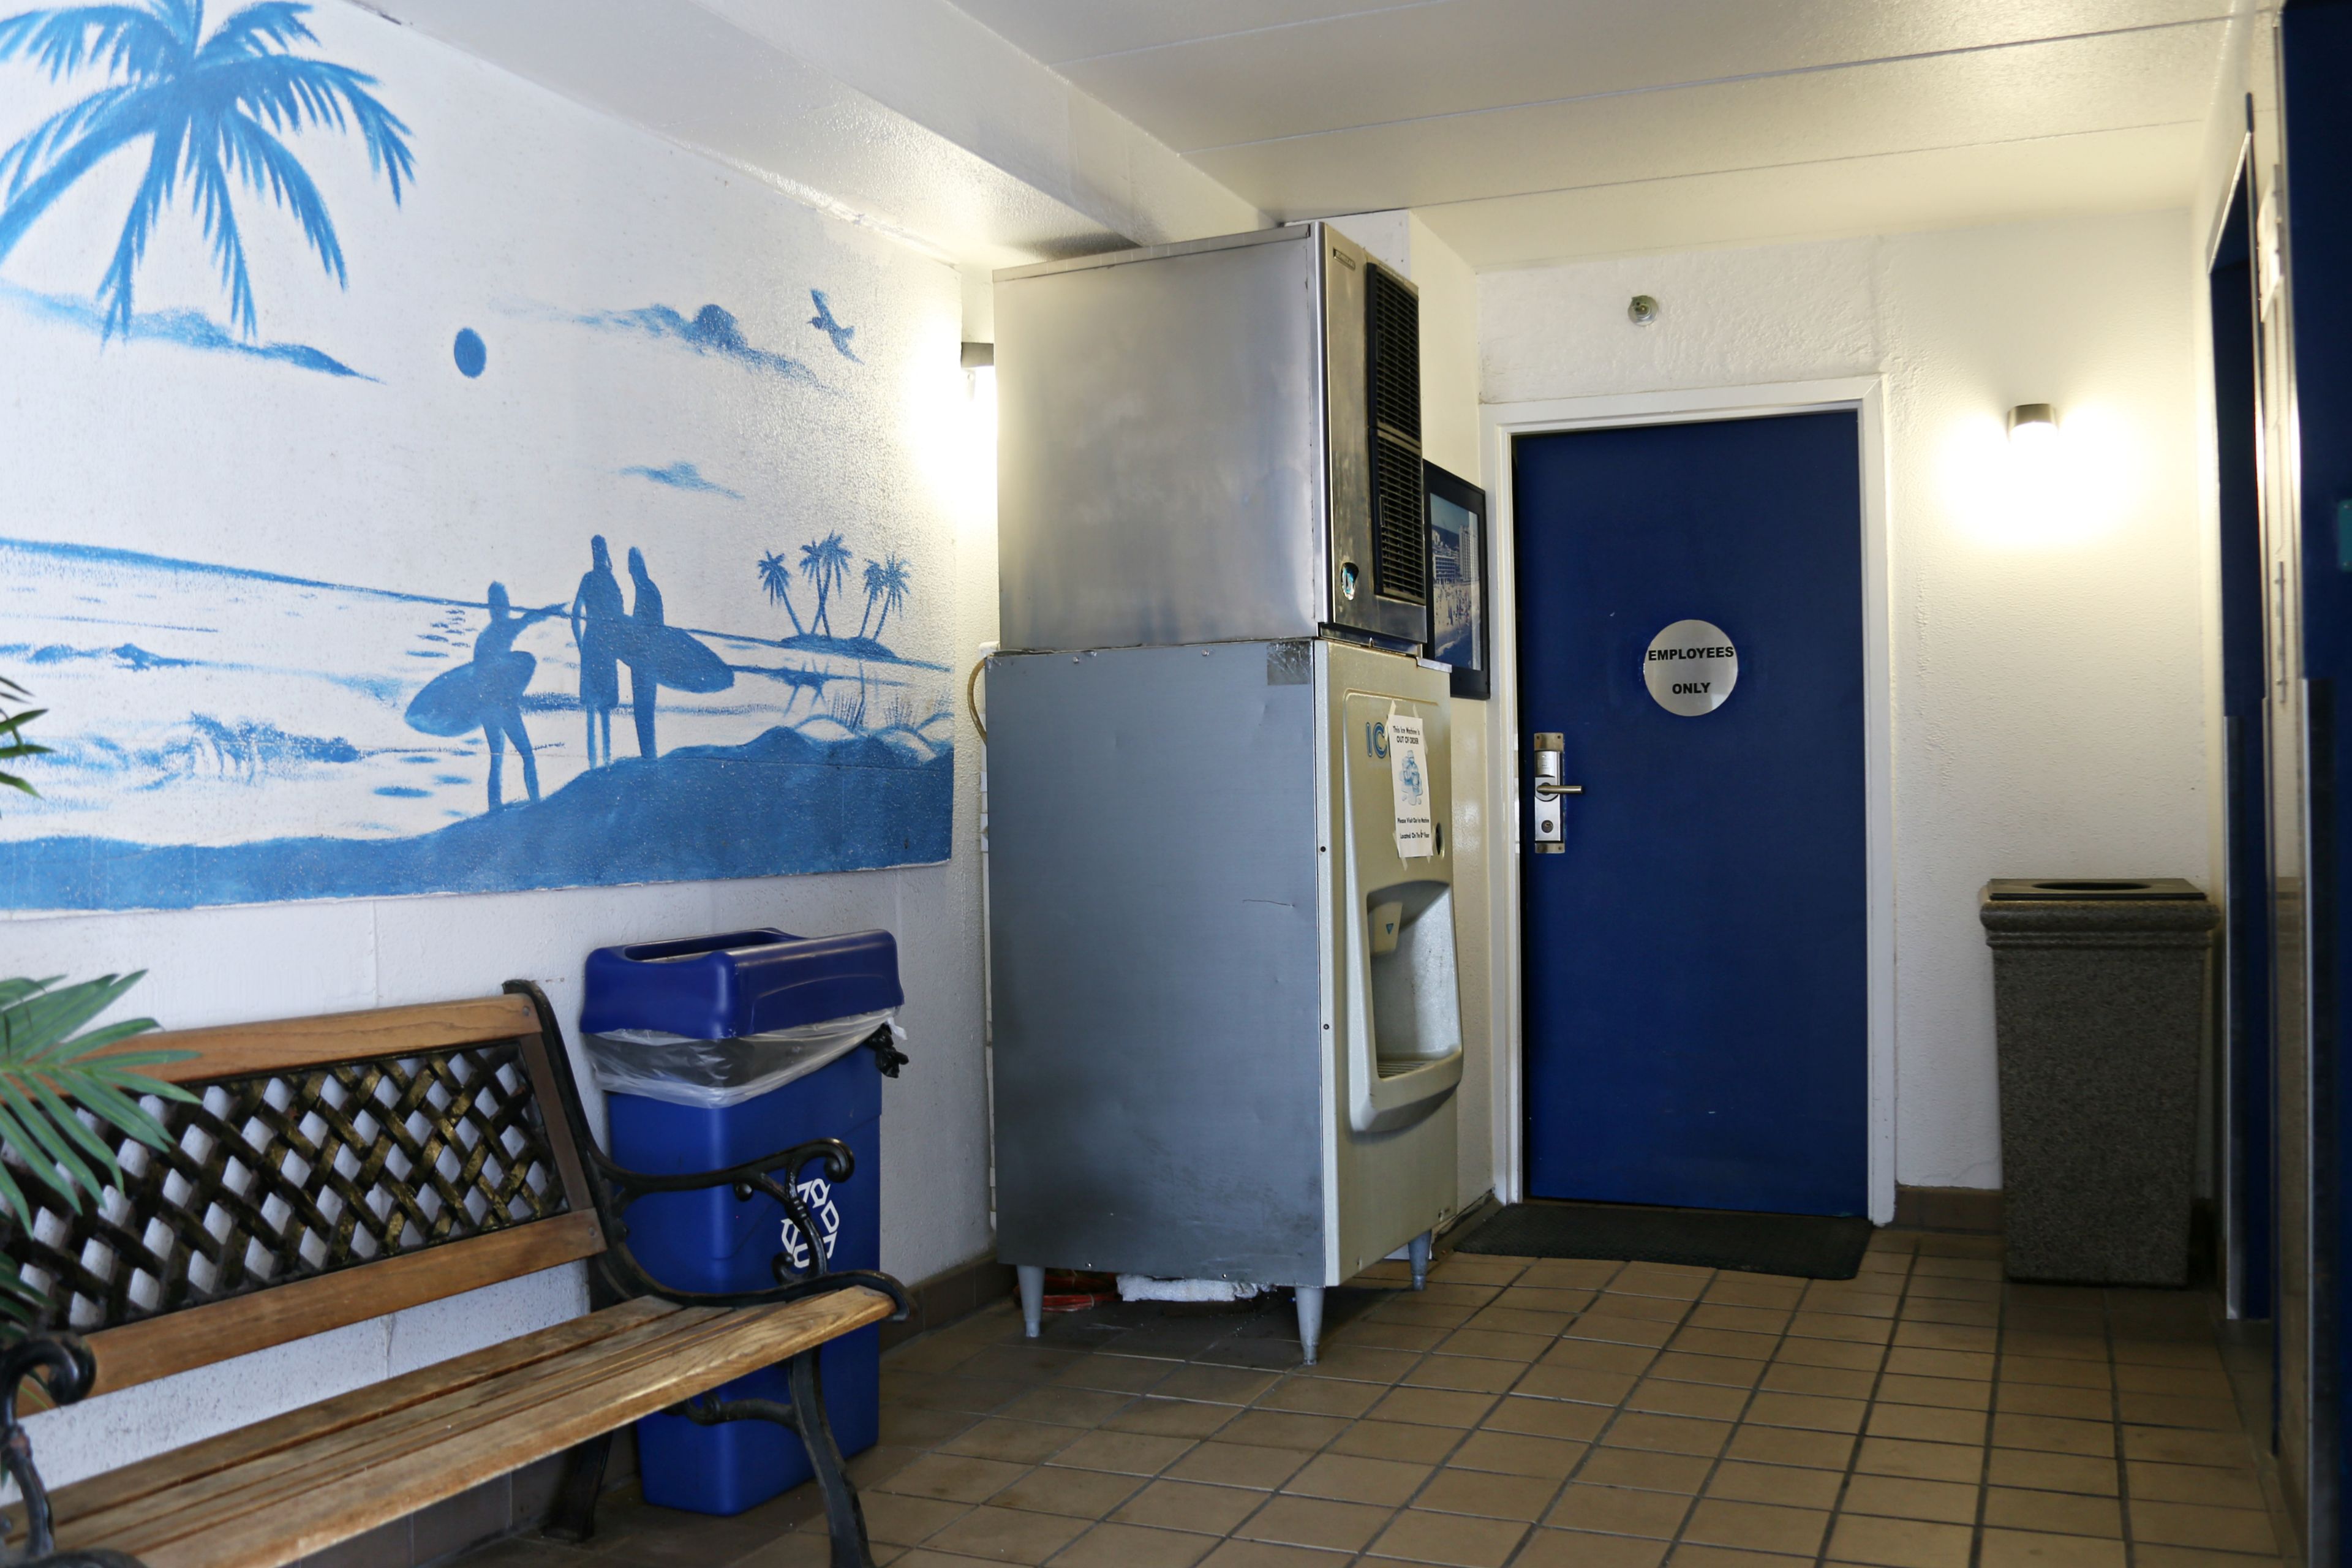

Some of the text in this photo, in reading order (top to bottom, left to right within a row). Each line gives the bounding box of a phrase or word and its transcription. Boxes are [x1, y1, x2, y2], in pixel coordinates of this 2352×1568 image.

[1648, 646, 1734, 661] EMPLOYEES
[1672, 682, 1711, 695] ONLY
[1366, 722, 1391, 759] IC
